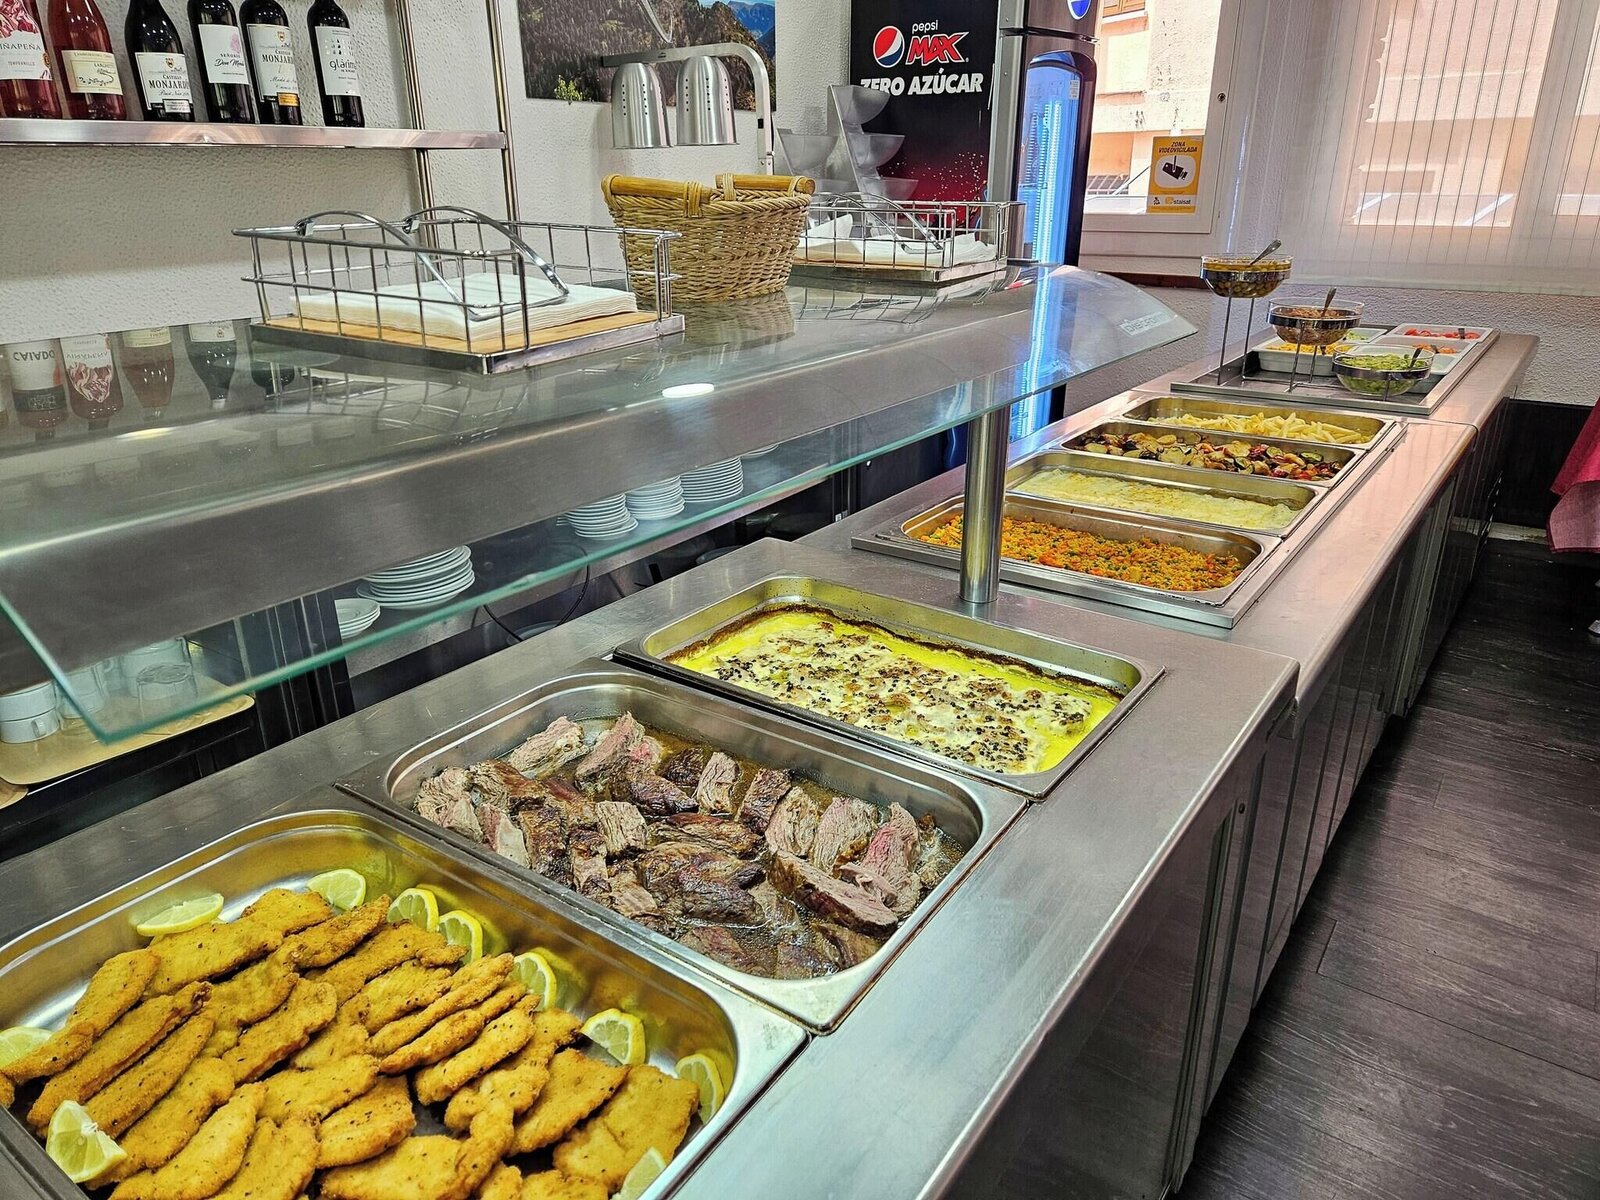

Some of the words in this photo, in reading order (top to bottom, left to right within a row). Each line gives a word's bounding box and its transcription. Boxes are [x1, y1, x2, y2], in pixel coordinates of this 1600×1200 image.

[912, 20, 938, 34] pepsi
[0, 42, 42, 51] IÑAPEÑA
[905, 31, 969, 66] MAX
[907, 67, 984, 95] AZÚCAR
